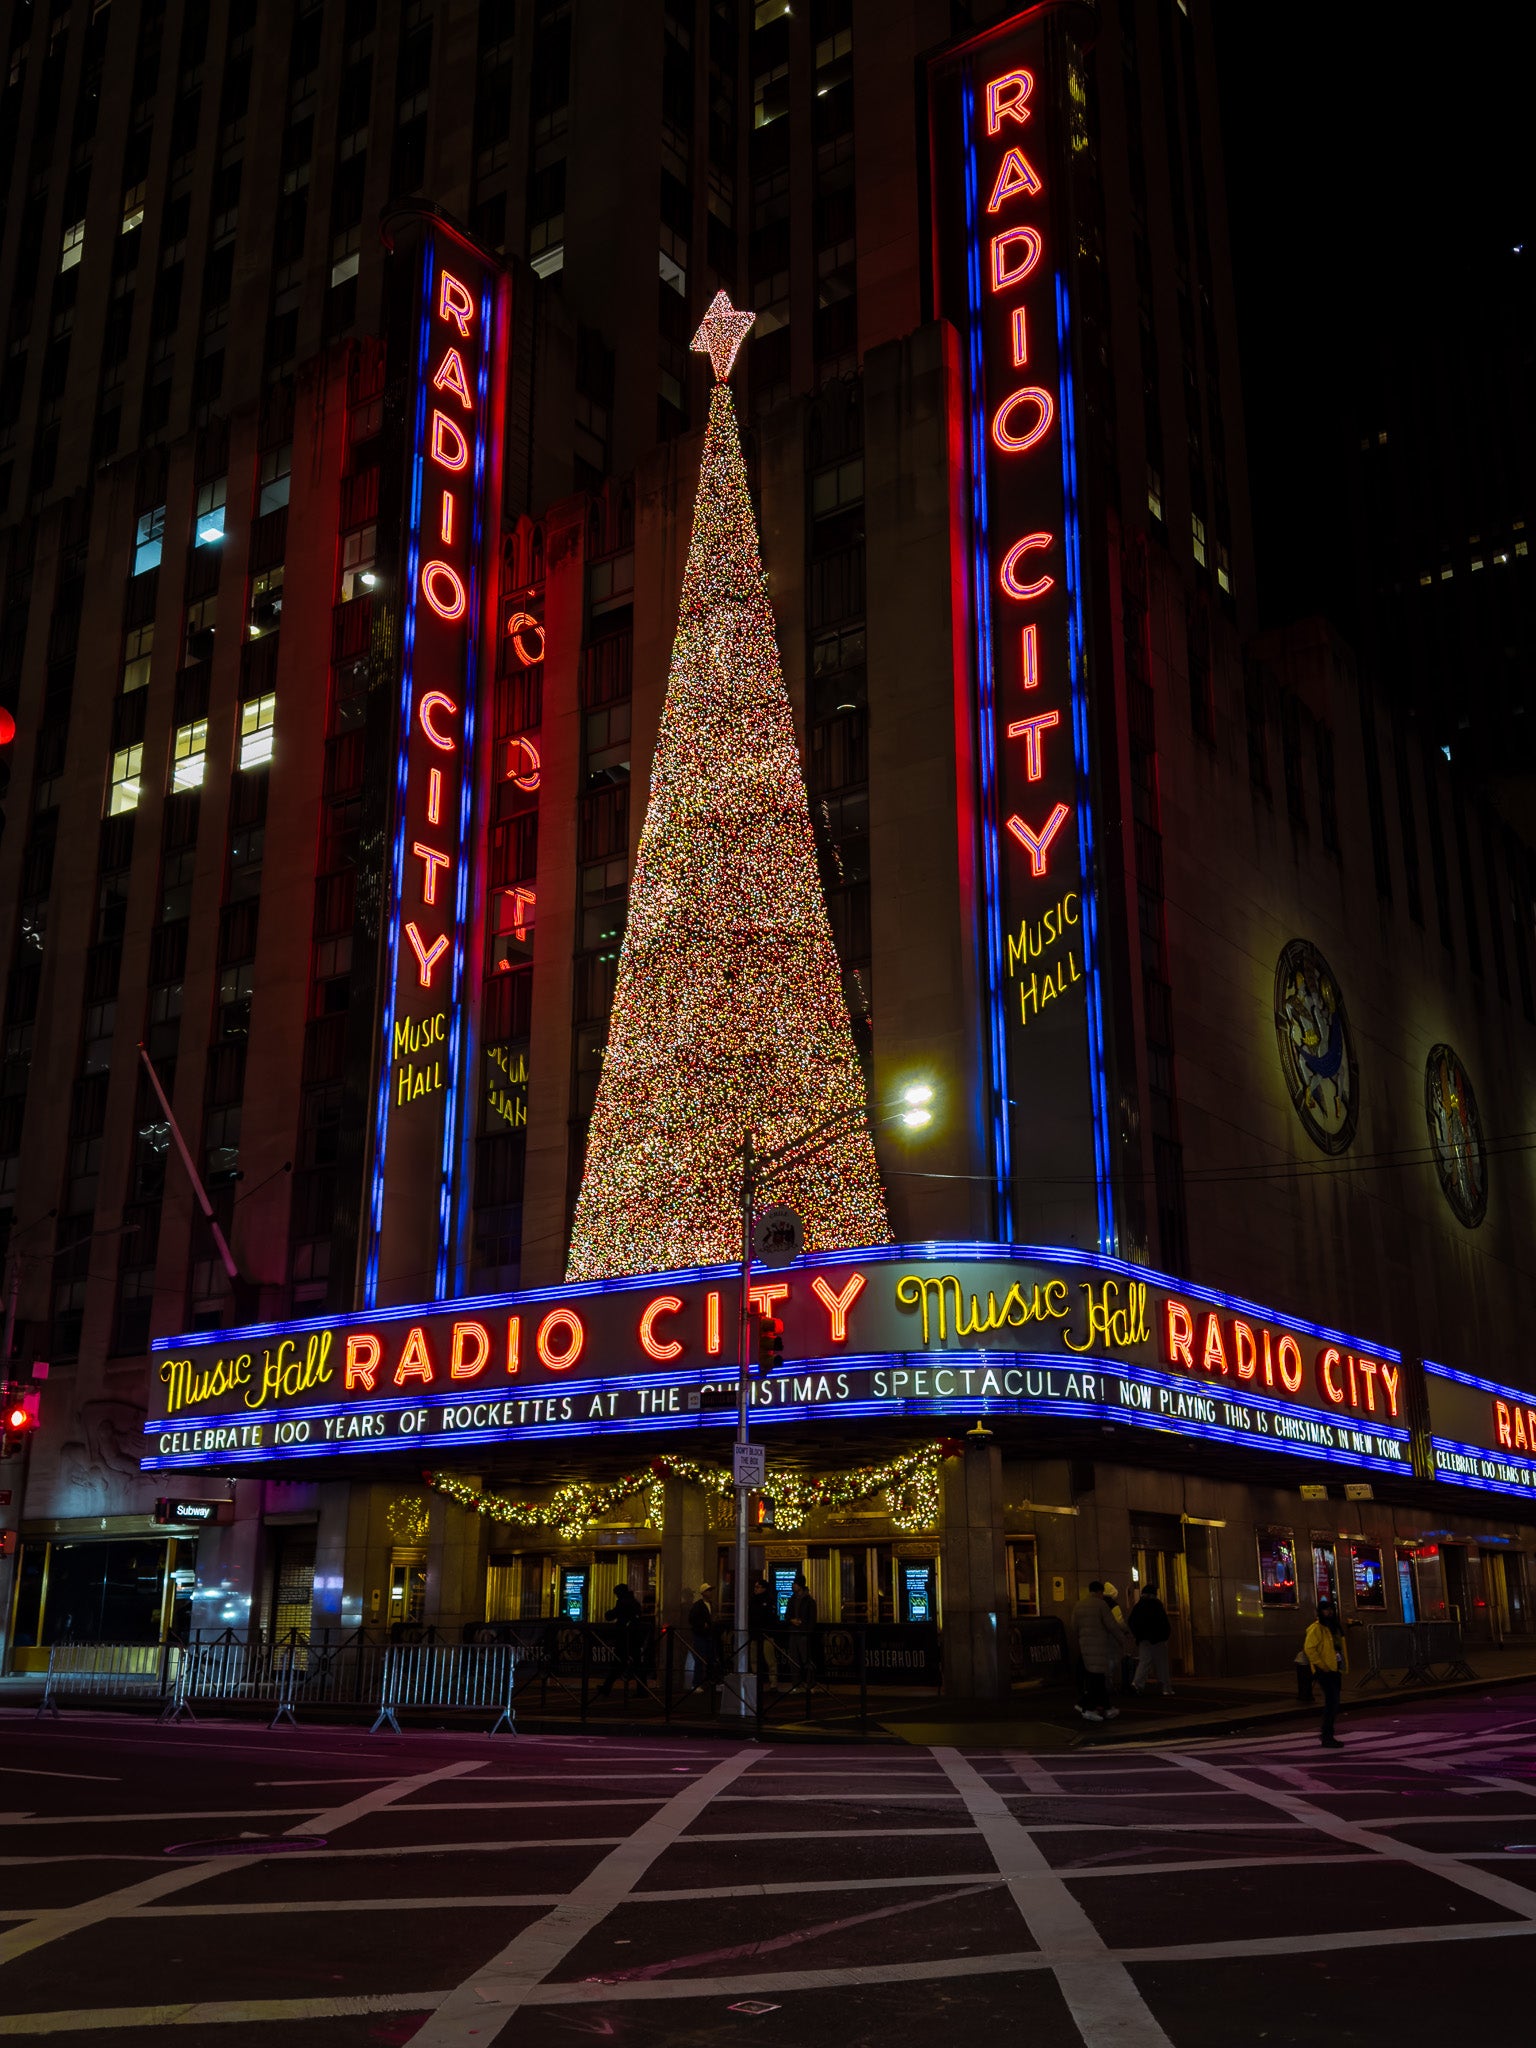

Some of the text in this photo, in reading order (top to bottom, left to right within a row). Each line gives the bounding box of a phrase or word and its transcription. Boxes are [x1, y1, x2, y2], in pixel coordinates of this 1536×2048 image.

[985, 69, 1069, 877] RADIO CITY
[404, 269, 474, 988] RADIO CITY
[1007, 893, 1078, 978] MUSIC
[1020, 951, 1082, 1025] HALL
[394, 1012, 445, 1060] MUSIC
[397, 1061, 442, 1106] HALL
[345, 1273, 867, 1391] RADIO CITY
[895, 1273, 1150, 1352] Music Hall
[161, 1329, 333, 1413] Music Hall
[1166, 1299, 1400, 1416] RADIO CITY
[159, 1425, 262, 1454] CELEBRATE
[274, 1420, 311, 1444] 100
[324, 1414, 385, 1440] YEARS
[399, 1409, 429, 1434] OF
[442, 1396, 572, 1430] ROCKETTES
[588, 1392, 619, 1418] AT
[637, 1387, 681, 1414] THE
[873, 1368, 1106, 1400] SPECTACULAR!
[1119, 1380, 1402, 1460] NOW PLAYING THIS IS CHRISTMAS IN NEW YORK
[740, 1456, 759, 1466] THE BOX
[748, 1447, 763, 1456] BLOCK
[1436, 1450, 1531, 1486] CELEBRATE 100 YEARS OF
[176, 1504, 211, 1519] Subway
[863, 1648, 926, 1669] SISTERHOOD
